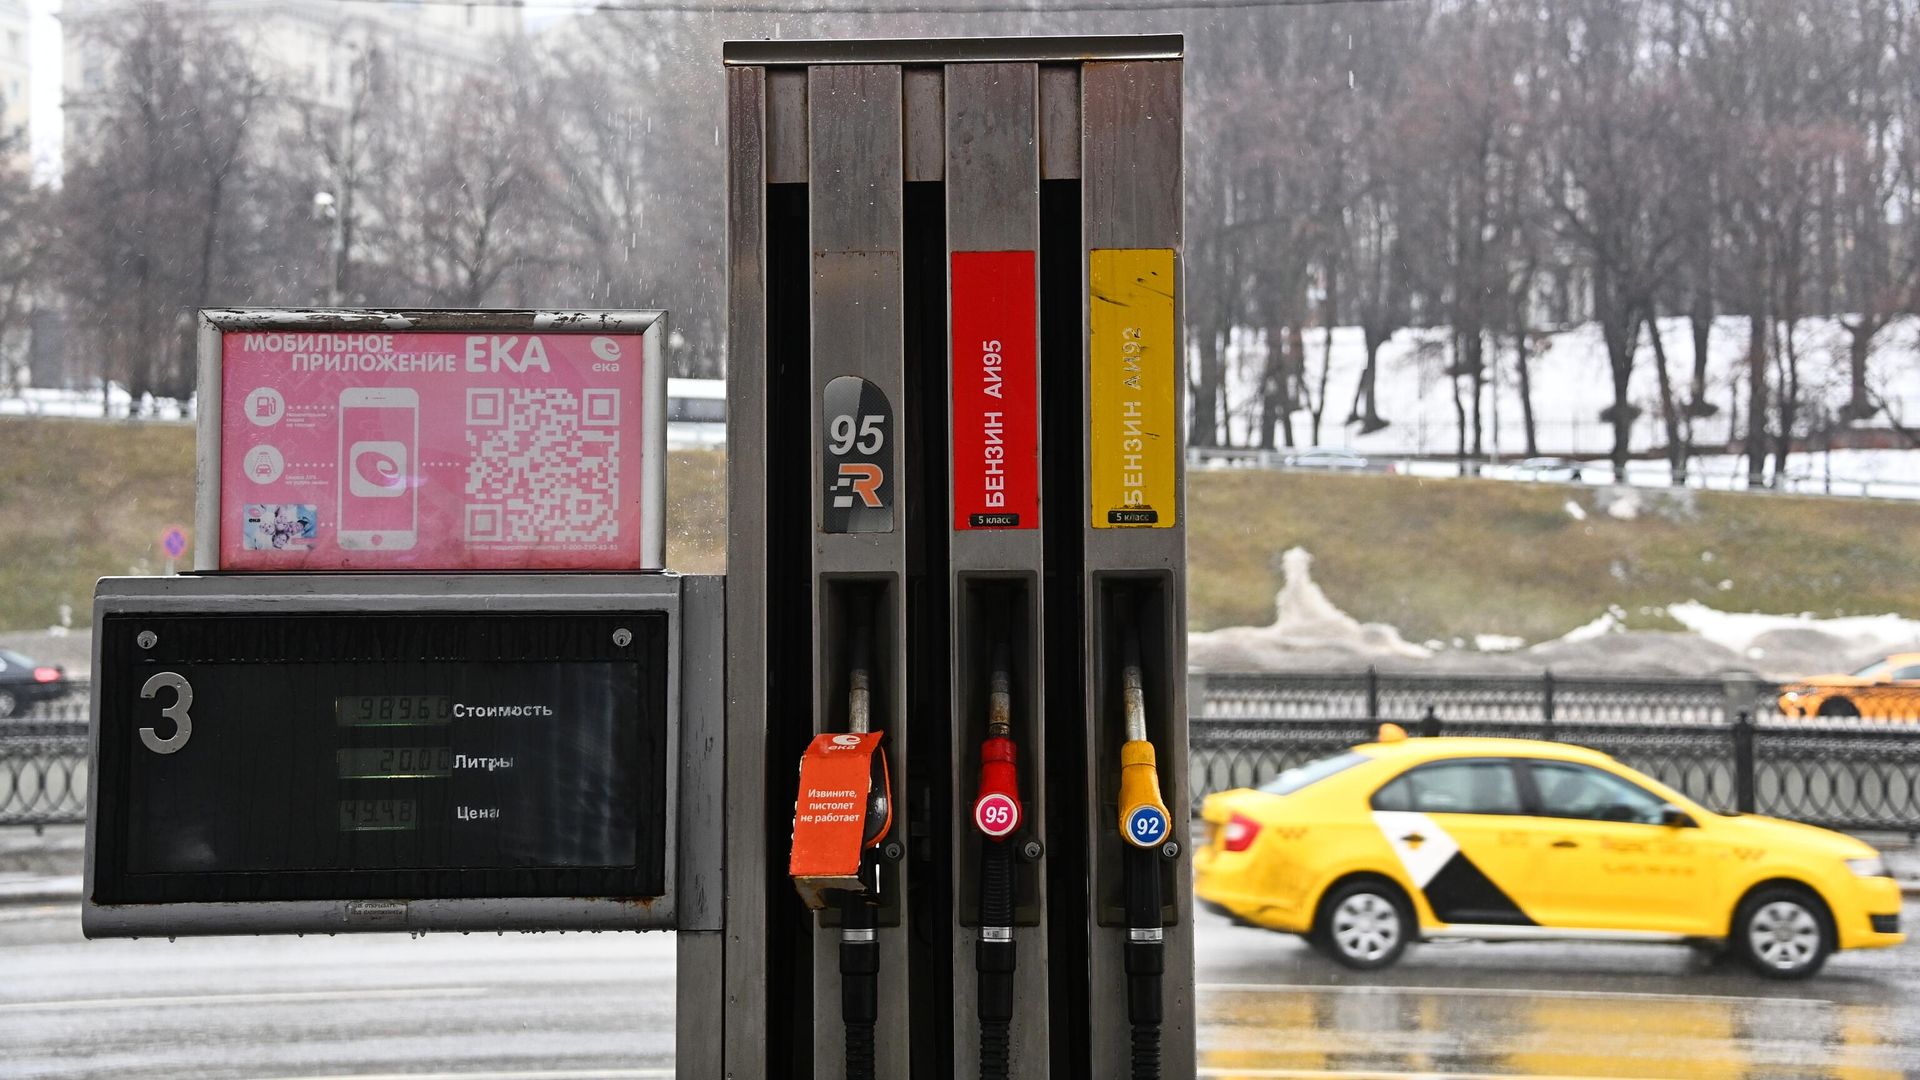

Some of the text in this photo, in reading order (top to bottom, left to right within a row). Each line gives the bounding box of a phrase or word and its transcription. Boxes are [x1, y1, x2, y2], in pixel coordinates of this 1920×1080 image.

[244, 335, 393, 353] МОБИЛЬНОЕ
[292, 354, 456, 372] ПРИЛОЖЕНИЕ
[466, 336, 550, 373] ЕКА
[983, 340, 1004, 507] БЕНЗИН АИ95
[1123, 327, 1143, 506] БЕНЗИН АИ92
[829, 415, 885, 455] 95
[978, 516, 984, 524] 5
[1116, 513, 1122, 521] 5
[139, 672, 193, 754] 3
[453, 703, 553, 717] Стоимость
[453, 754, 514, 771] Литры
[808, 789, 857, 798] Извините,
[809, 802, 854, 810] пистолет
[985, 806, 1008, 824] 95
[815, 813, 860, 824] работает
[1137, 817, 1159, 835] 92
